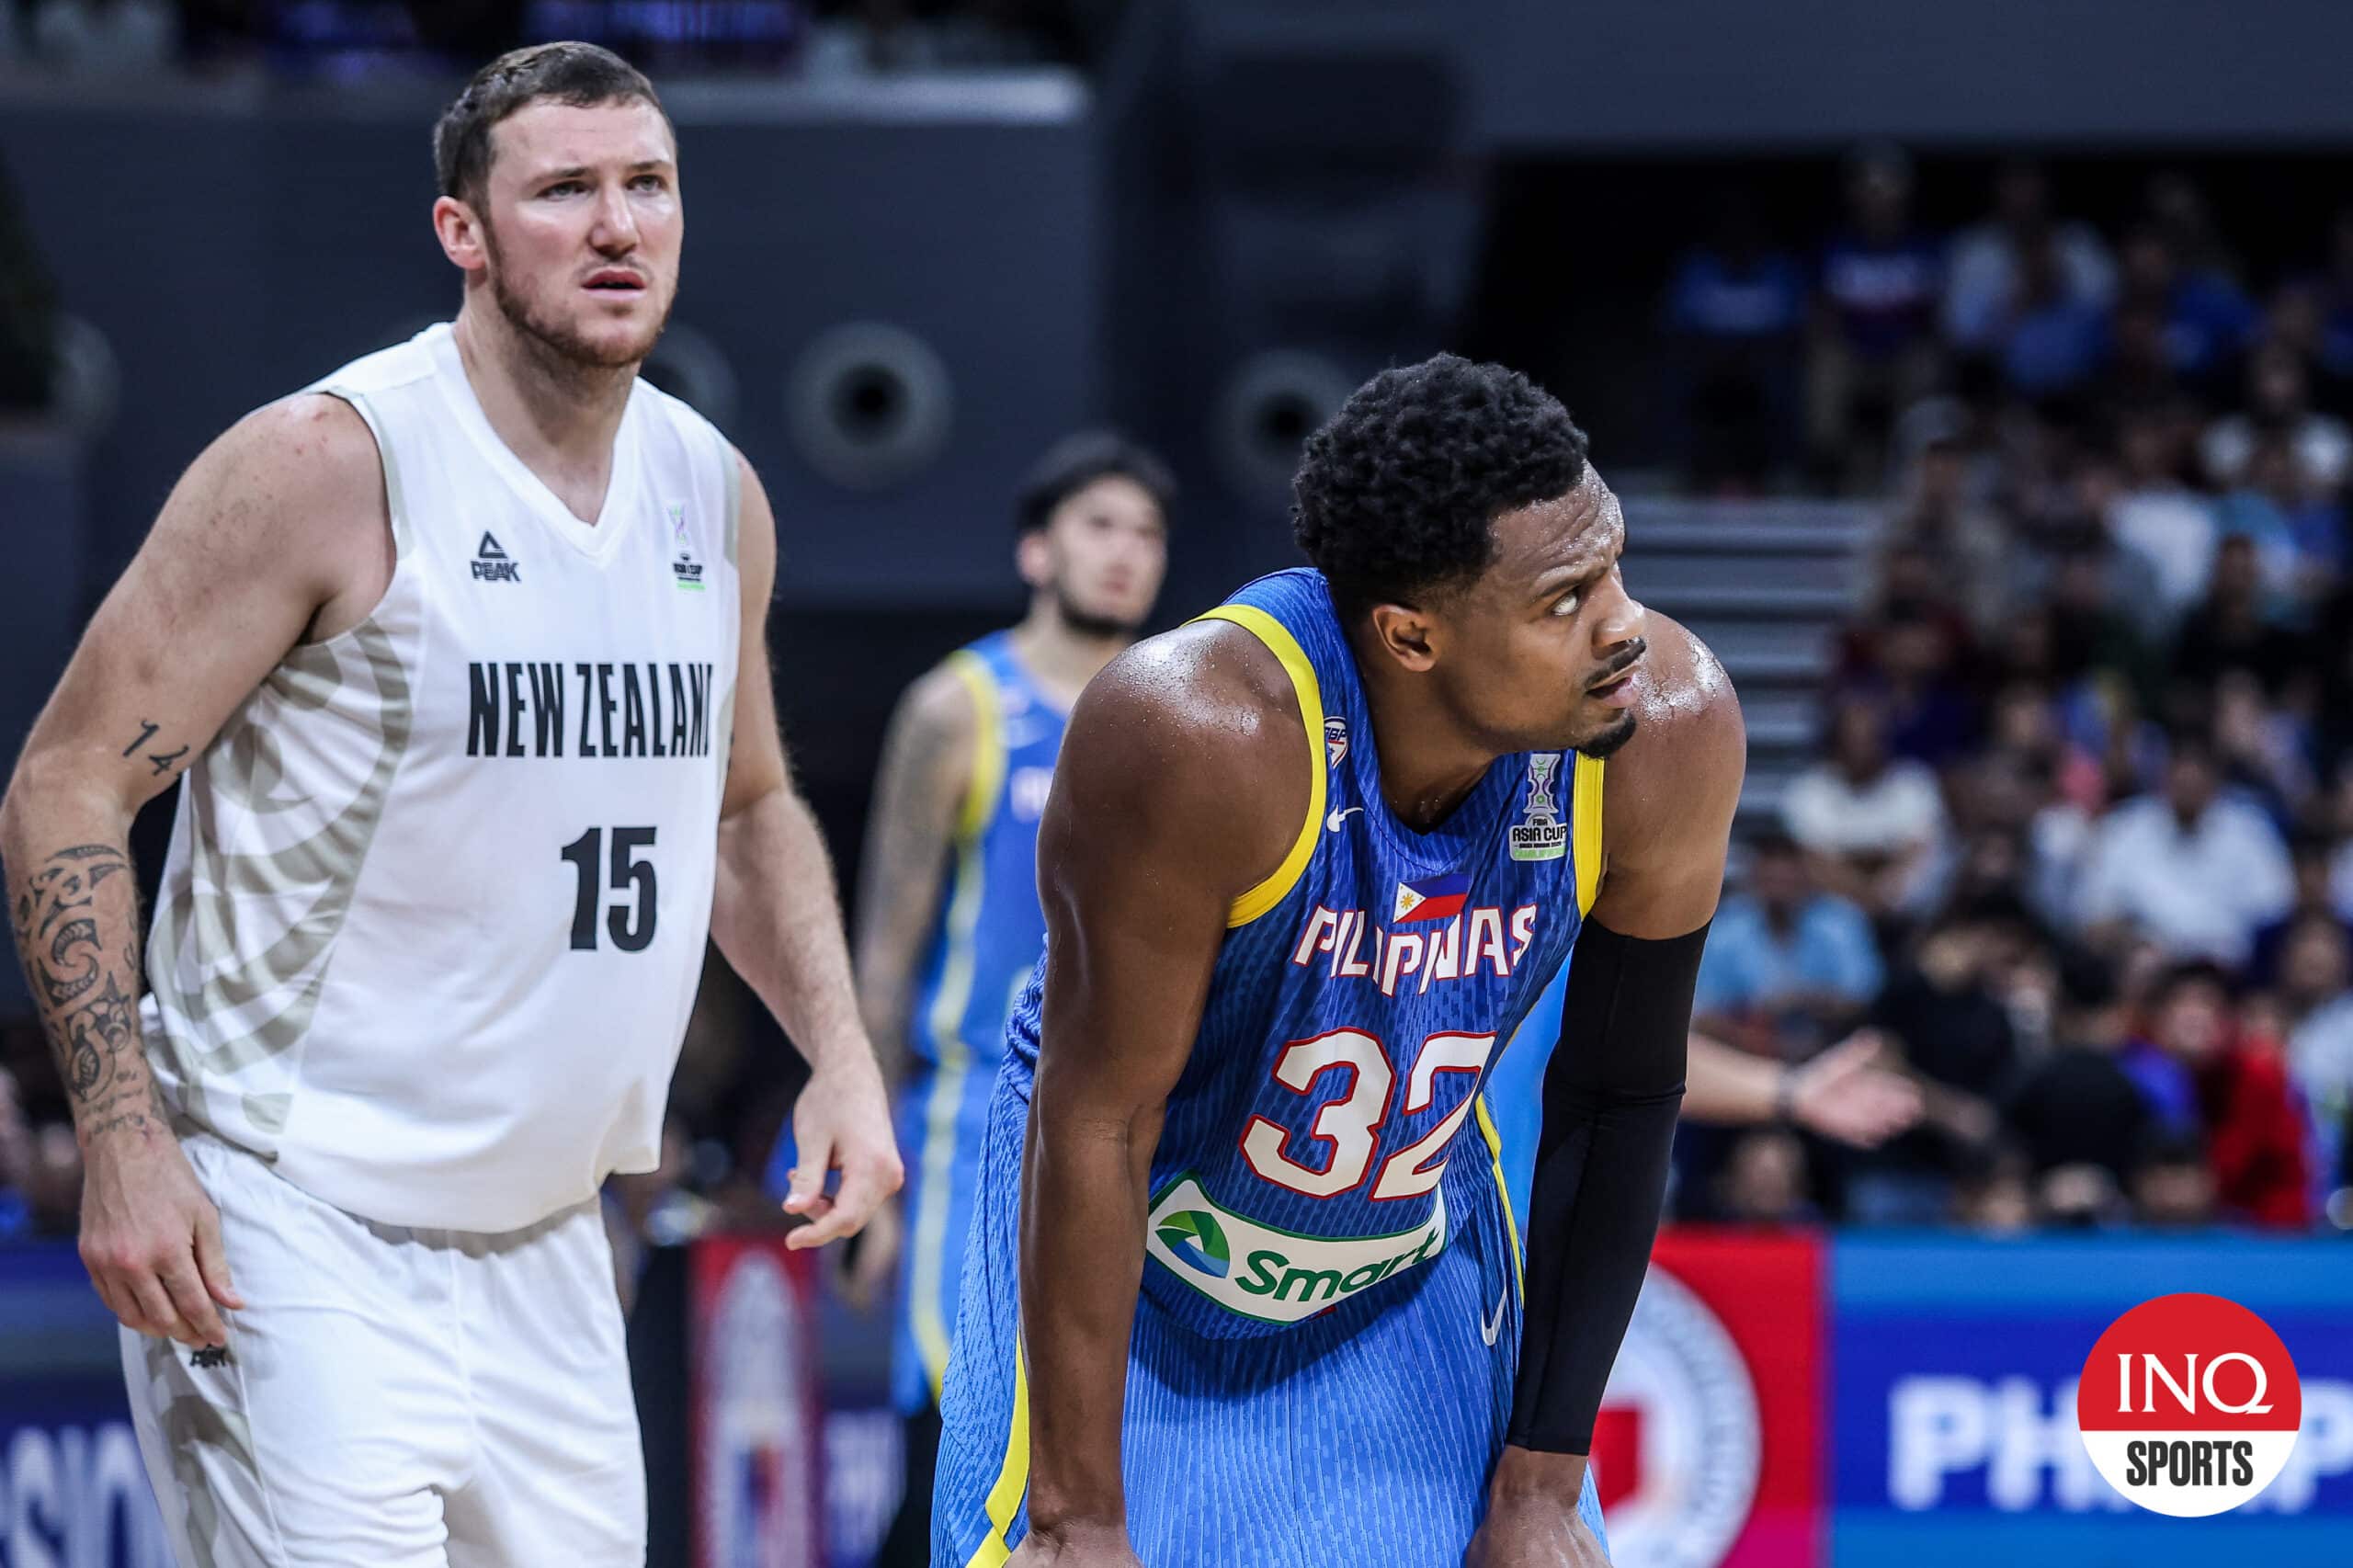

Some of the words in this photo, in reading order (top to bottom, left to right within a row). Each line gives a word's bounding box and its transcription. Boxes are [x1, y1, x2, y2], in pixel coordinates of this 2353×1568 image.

[471, 561, 520, 581] PEAK
[466, 662, 563, 757] NEW
[575, 662, 712, 757] ZEALAN
[1512, 827, 1541, 842] ASIA
[1544, 825, 1567, 841] CUP
[561, 826, 657, 952] 15
[1293, 903, 1538, 997] PILIPINAS
[1238, 1027, 1497, 1201] 32
[1234, 1226, 1441, 1302] Smart
